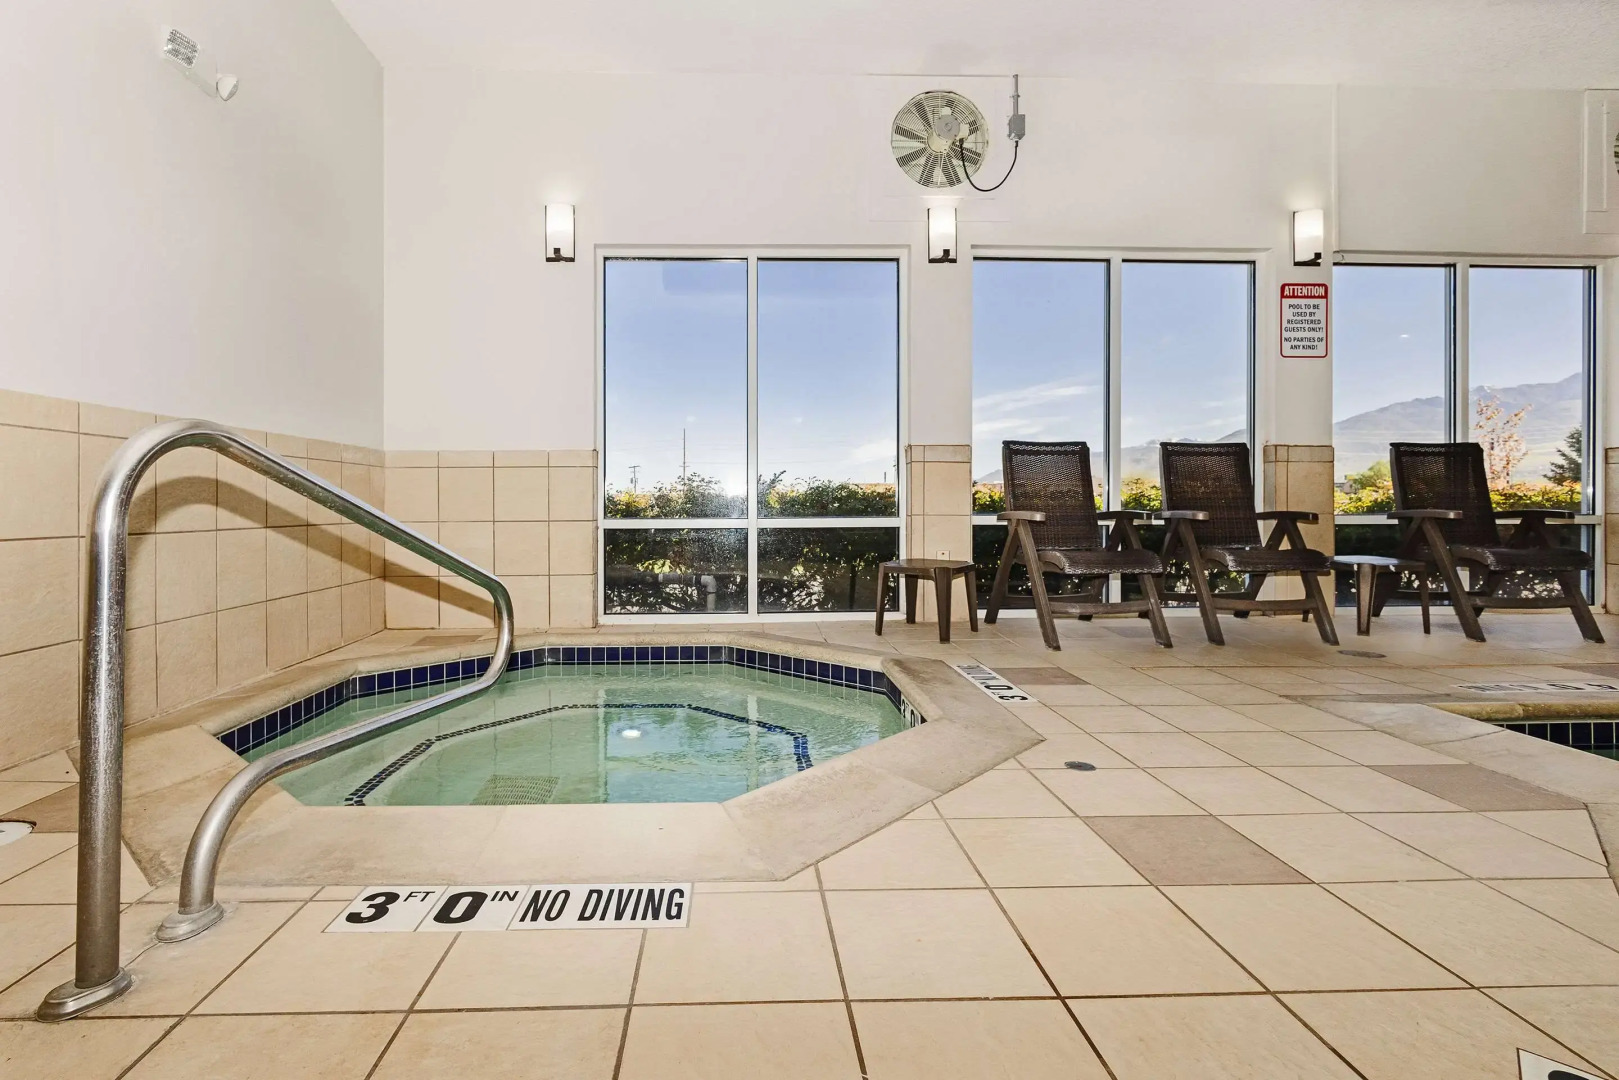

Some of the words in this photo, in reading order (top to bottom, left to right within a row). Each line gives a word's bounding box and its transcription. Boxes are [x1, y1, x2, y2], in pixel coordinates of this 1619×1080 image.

[1284, 285, 1325, 297] ATTENTION
[345, 891, 400, 924] 3
[403, 890, 436, 902] FT
[432, 891, 489, 924] 0
[490, 890, 520, 902] IN
[518, 889, 571, 923] NO
[576, 887, 685, 922] DIVING
